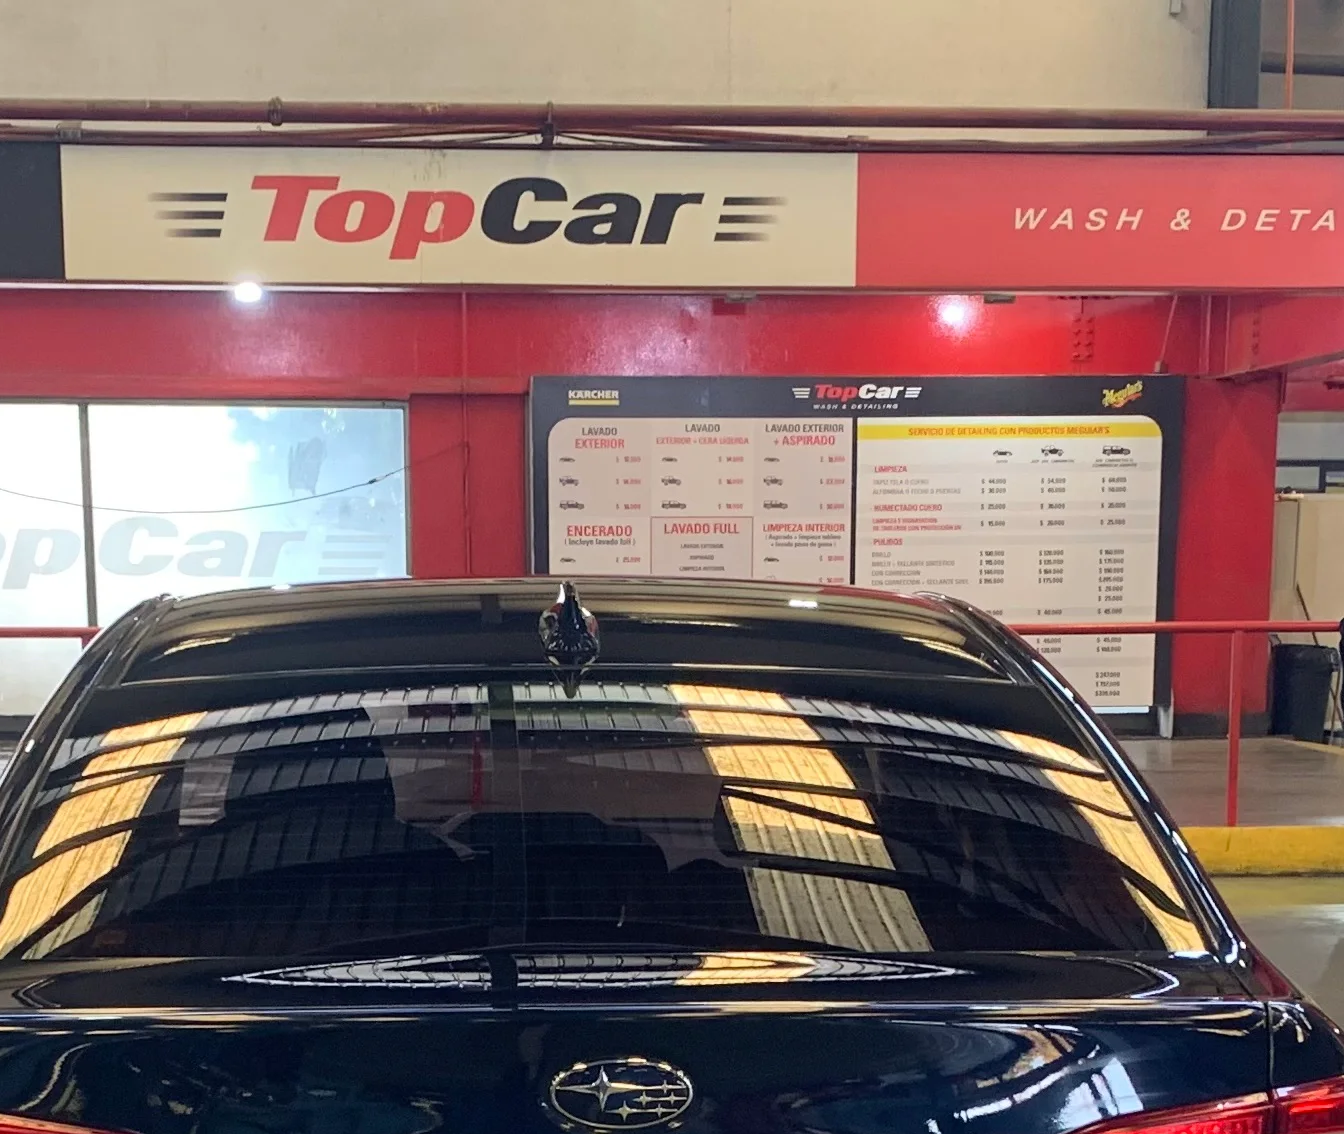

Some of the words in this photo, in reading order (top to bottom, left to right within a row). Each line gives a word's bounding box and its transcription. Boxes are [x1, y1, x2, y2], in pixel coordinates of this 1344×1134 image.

[250, 174, 704, 260] TopCar
[1013, 207, 1144, 231] WASH
[1169, 208, 1193, 231] &
[815, 383, 904, 402] TopCar
[581, 427, 618, 436] LAVADO
[685, 423, 721, 433] LAVADO
[765, 423, 801, 433] LAVADO
[802, 423, 844, 433] EXTERIOR
[908, 427, 943, 436] SERVICIO
[945, 427, 956, 436] DE
[957, 427, 998, 436] DETAILING
[1018, 426, 1065, 435] PRODUCTOS
[575, 438, 625, 449] EXTERIOR
[782, 435, 835, 446] ASPIRADO
[566, 525, 633, 537] ENCERADO
[664, 523, 710, 534] LAVADO
[713, 523, 740, 534] FULL
[762, 523, 803, 532] LIMPIEZA
[805, 523, 845, 532] INTERIOR
